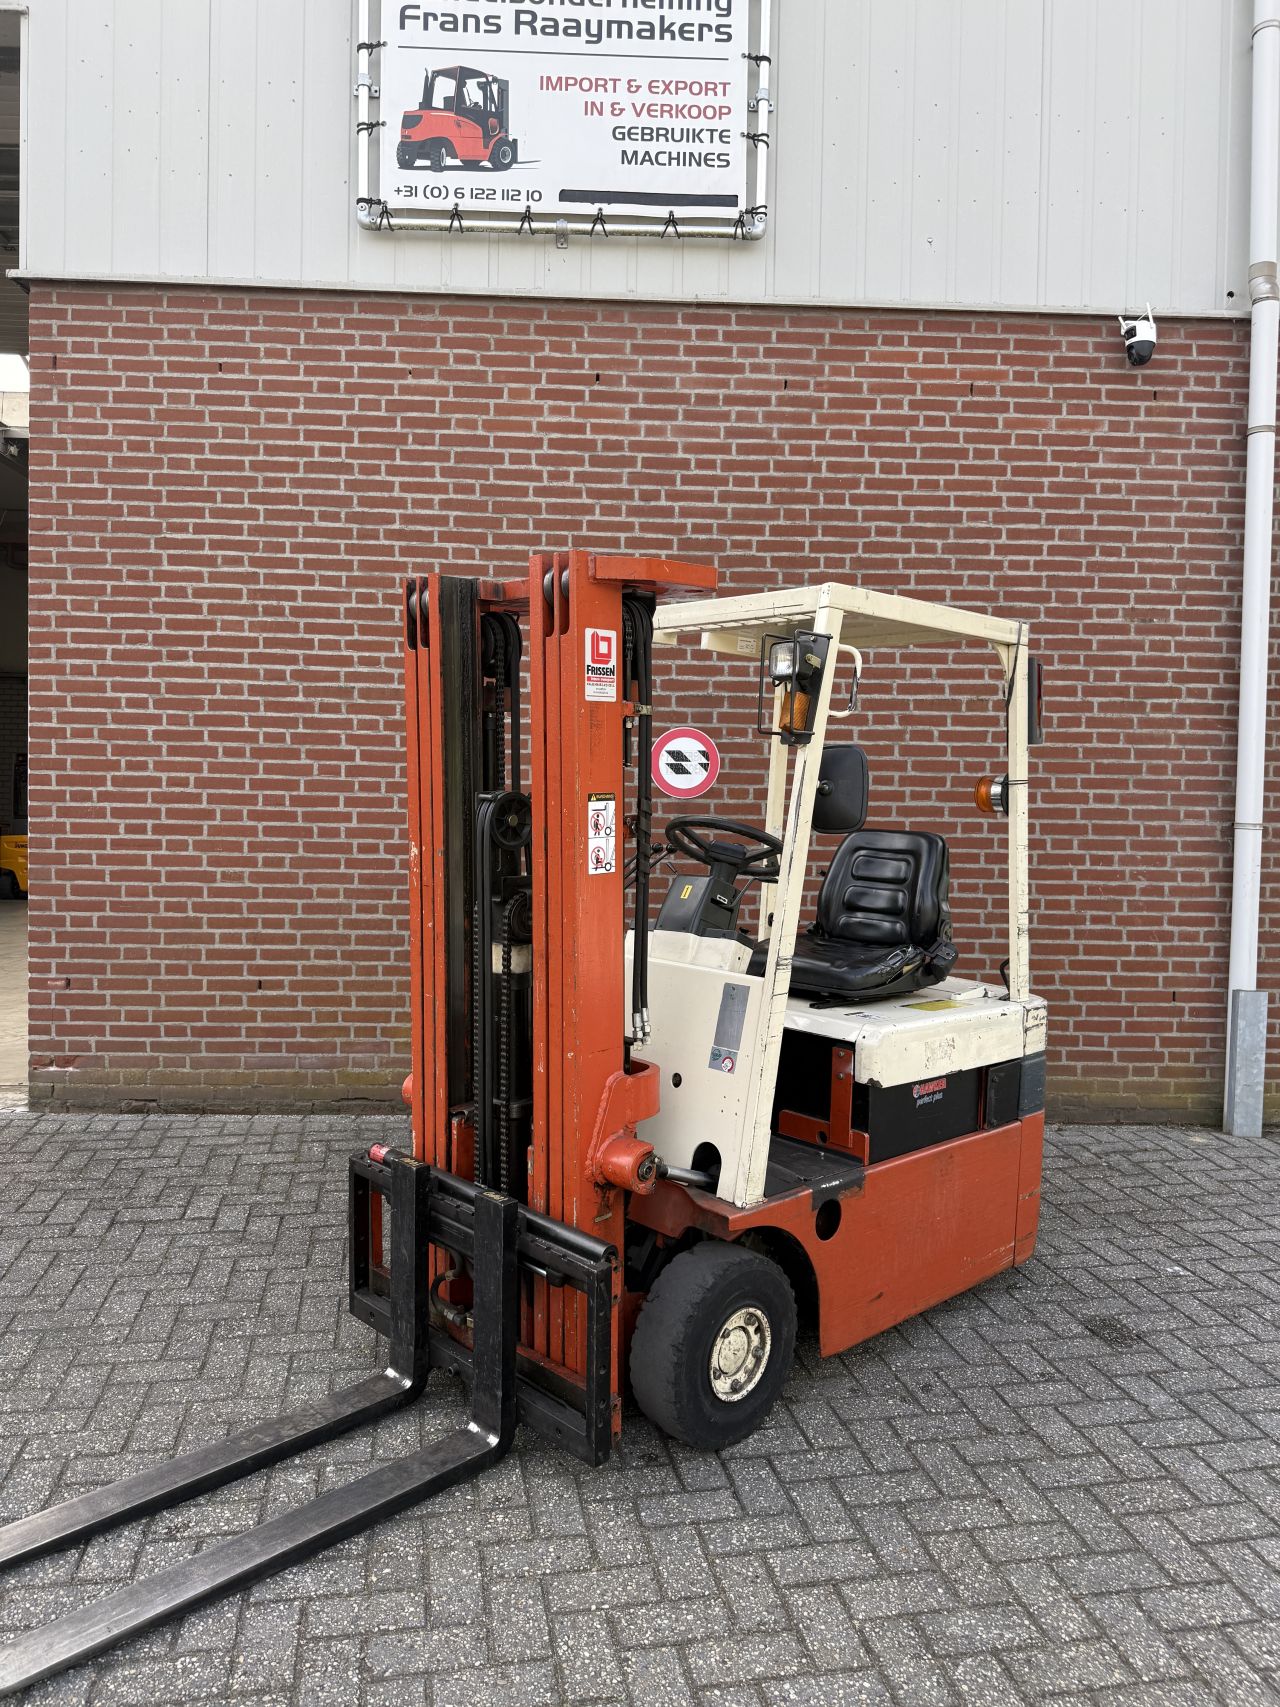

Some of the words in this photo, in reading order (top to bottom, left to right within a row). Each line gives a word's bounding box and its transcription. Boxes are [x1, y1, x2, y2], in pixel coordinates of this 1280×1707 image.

[399, 4, 502, 34] Frans
[514, 9, 733, 45] Raaymakers
[539, 75, 621, 94] IMPORT
[626, 78, 642, 94] &
[647, 79, 731, 97] EXPORT
[584, 100, 604, 116] IN
[610, 101, 625, 117] &
[631, 102, 732, 120] VERKOOP
[611, 125, 731, 144] GEBRUIKTE
[620, 149, 731, 168] MACHINES
[394, 184, 418, 198] +31
[423, 184, 449, 200] (0)
[453, 187, 465, 200] 6
[470, 187, 497, 201] 122
[501, 188, 522, 201] 112
[526, 189, 543, 202] 10
[586, 664, 615, 677] FRISSEN
